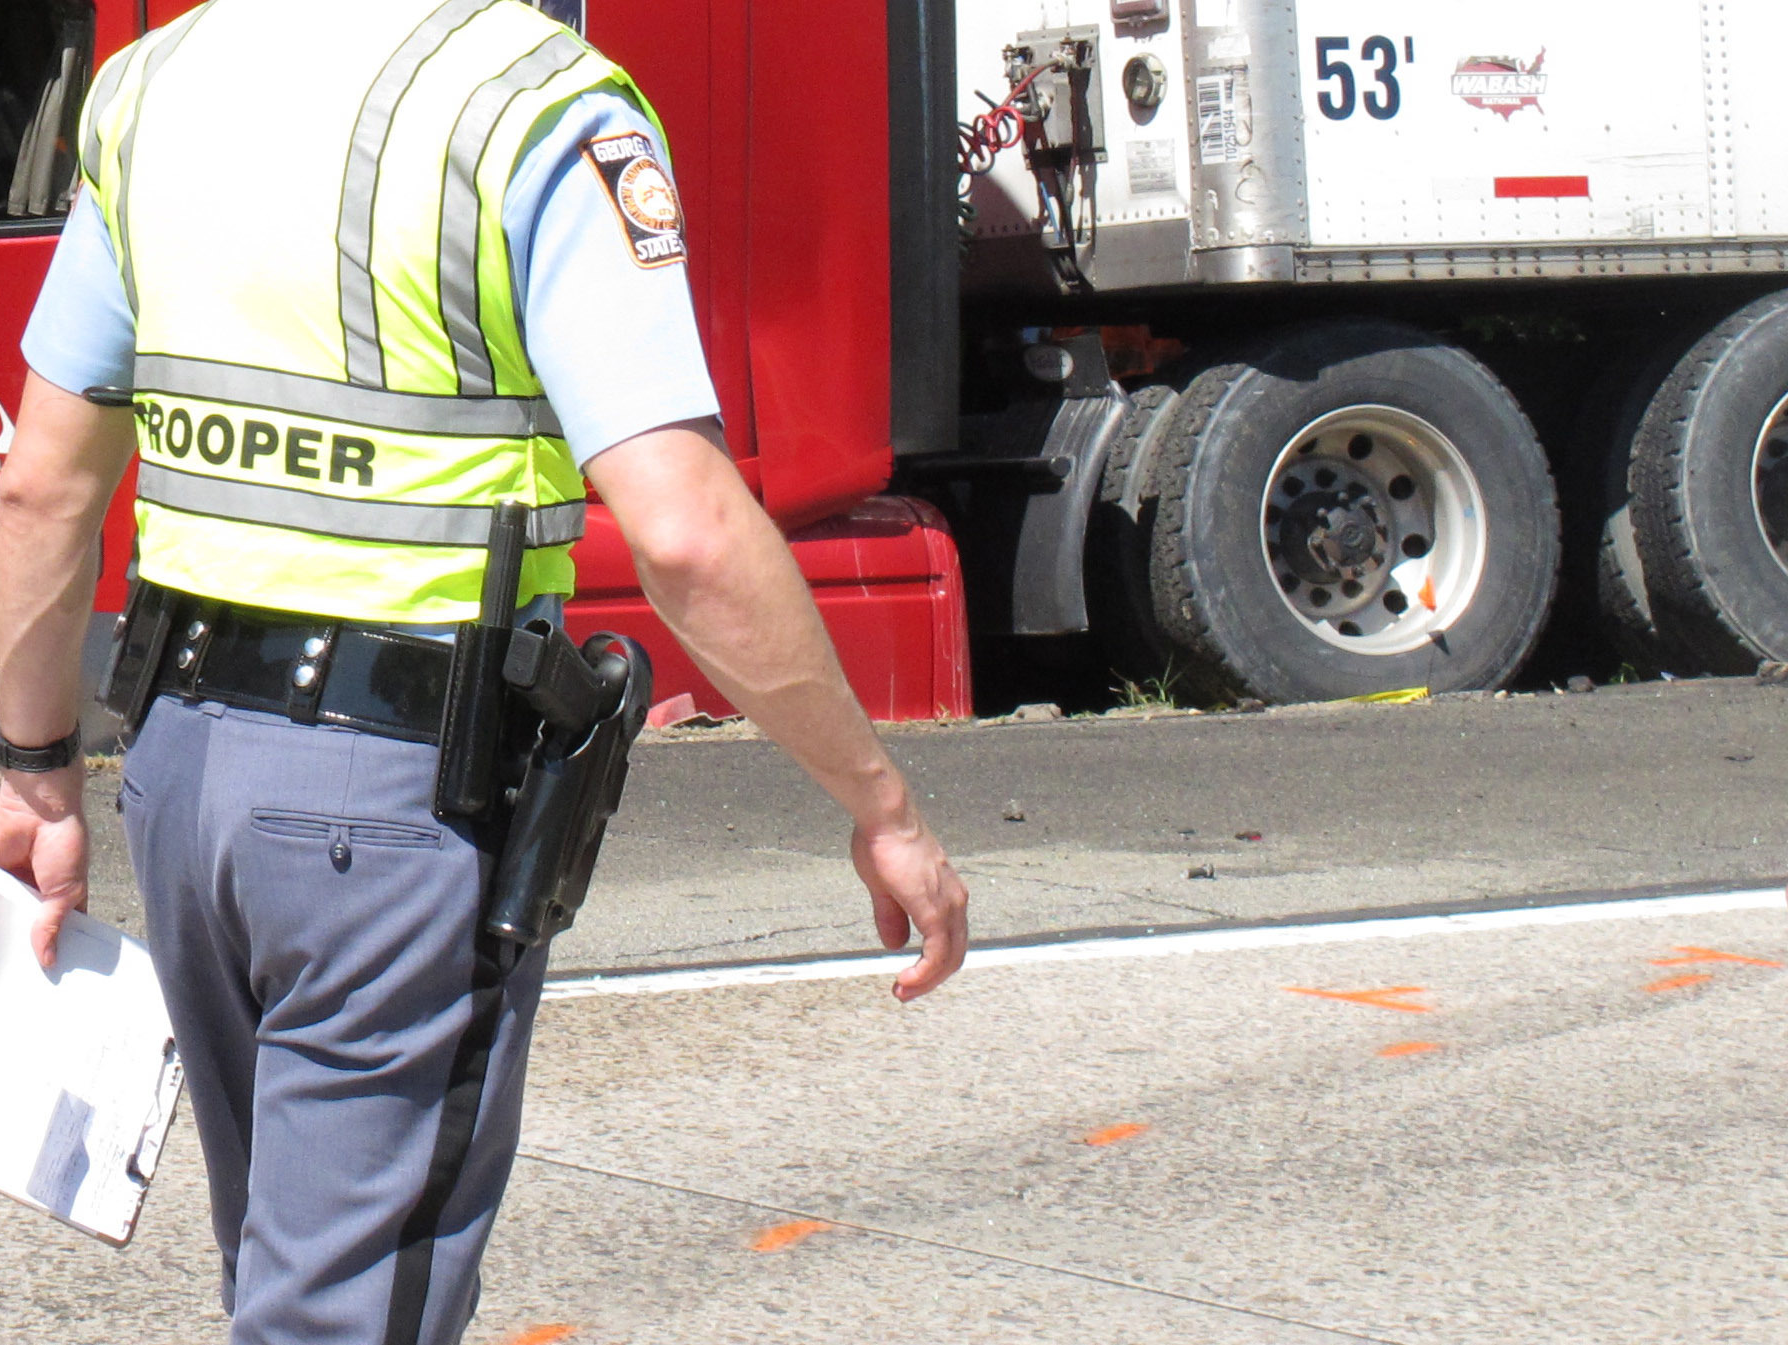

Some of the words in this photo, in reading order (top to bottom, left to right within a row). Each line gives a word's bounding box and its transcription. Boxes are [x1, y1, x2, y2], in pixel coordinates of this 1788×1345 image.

[1315, 35, 1413, 121] 53'
[1453, 75, 1545, 94] WABASH
[593, 136, 653, 162] GEORG
[635, 234, 682, 260] STATE
